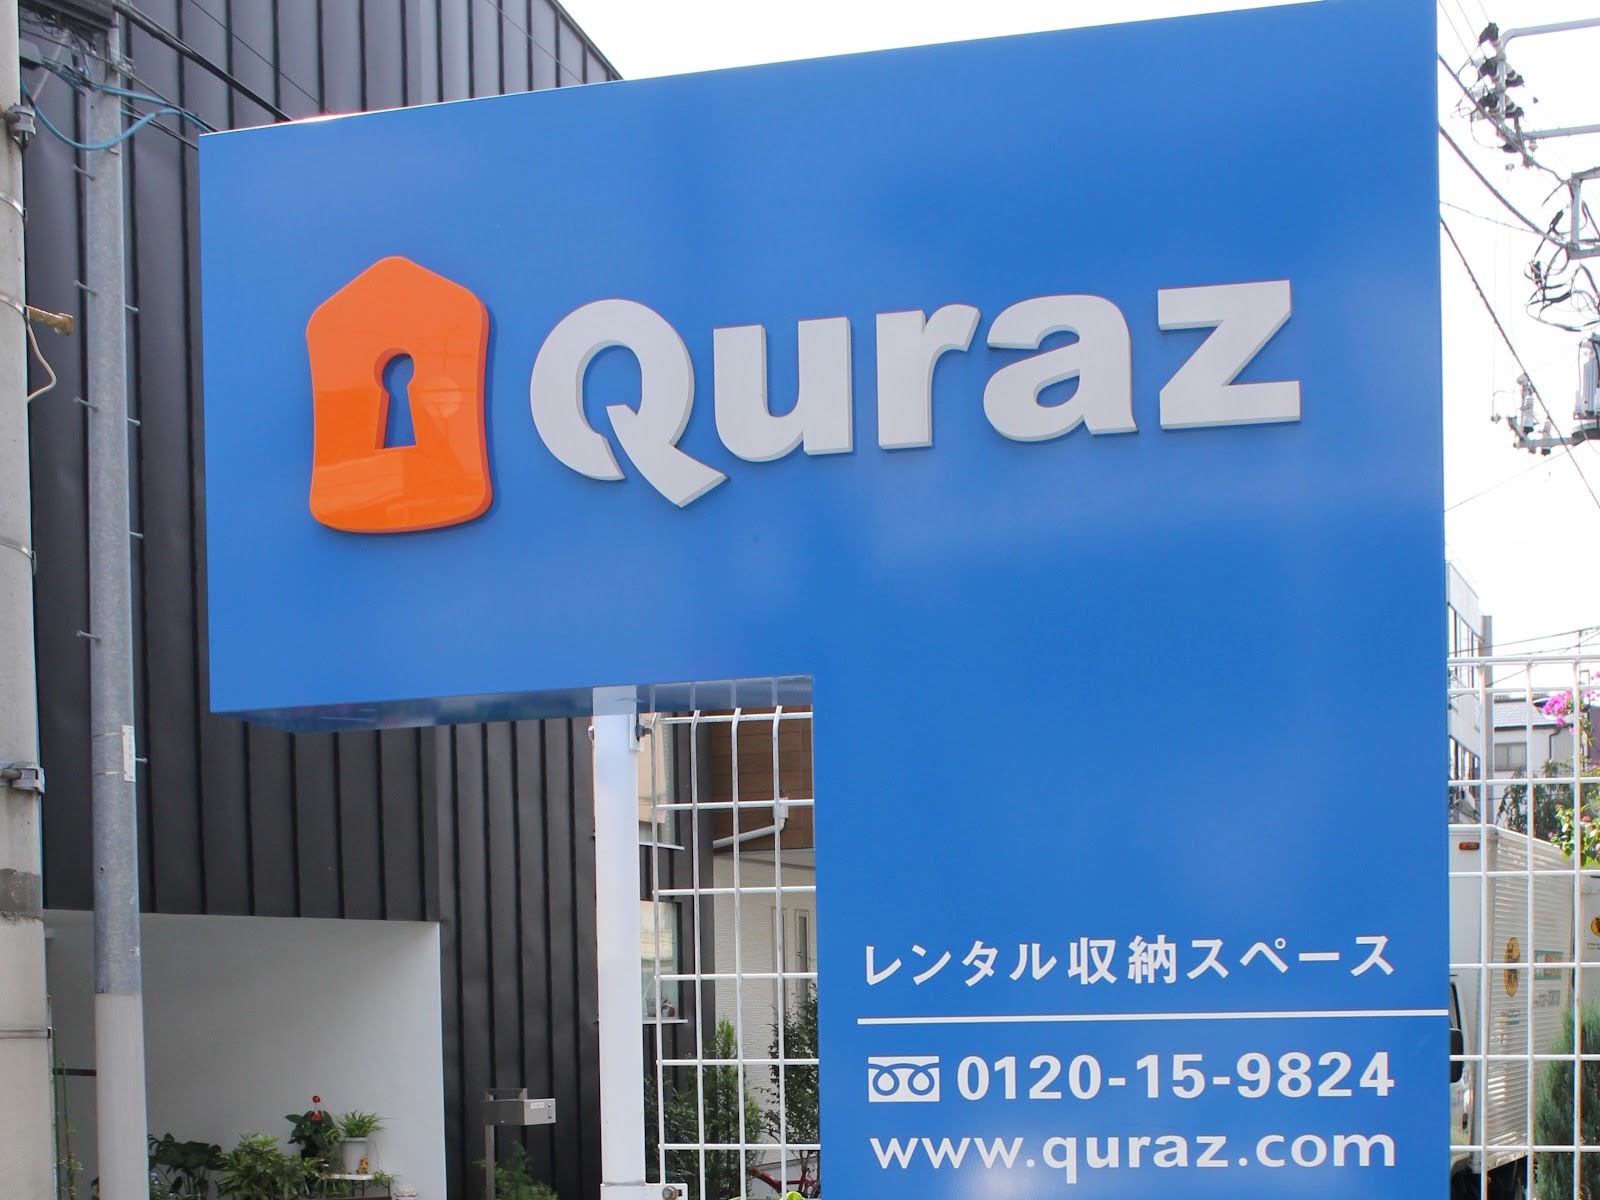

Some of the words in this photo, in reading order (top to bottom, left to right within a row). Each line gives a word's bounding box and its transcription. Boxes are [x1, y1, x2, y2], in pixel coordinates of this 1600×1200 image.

[529, 279, 1302, 508] Quraz
[865, 934, 1394, 987] レンタル収納スペース
[956, 1051, 1395, 1101] 0120-15-9824
[869, 1134, 1395, 1185] www.quraz.com
